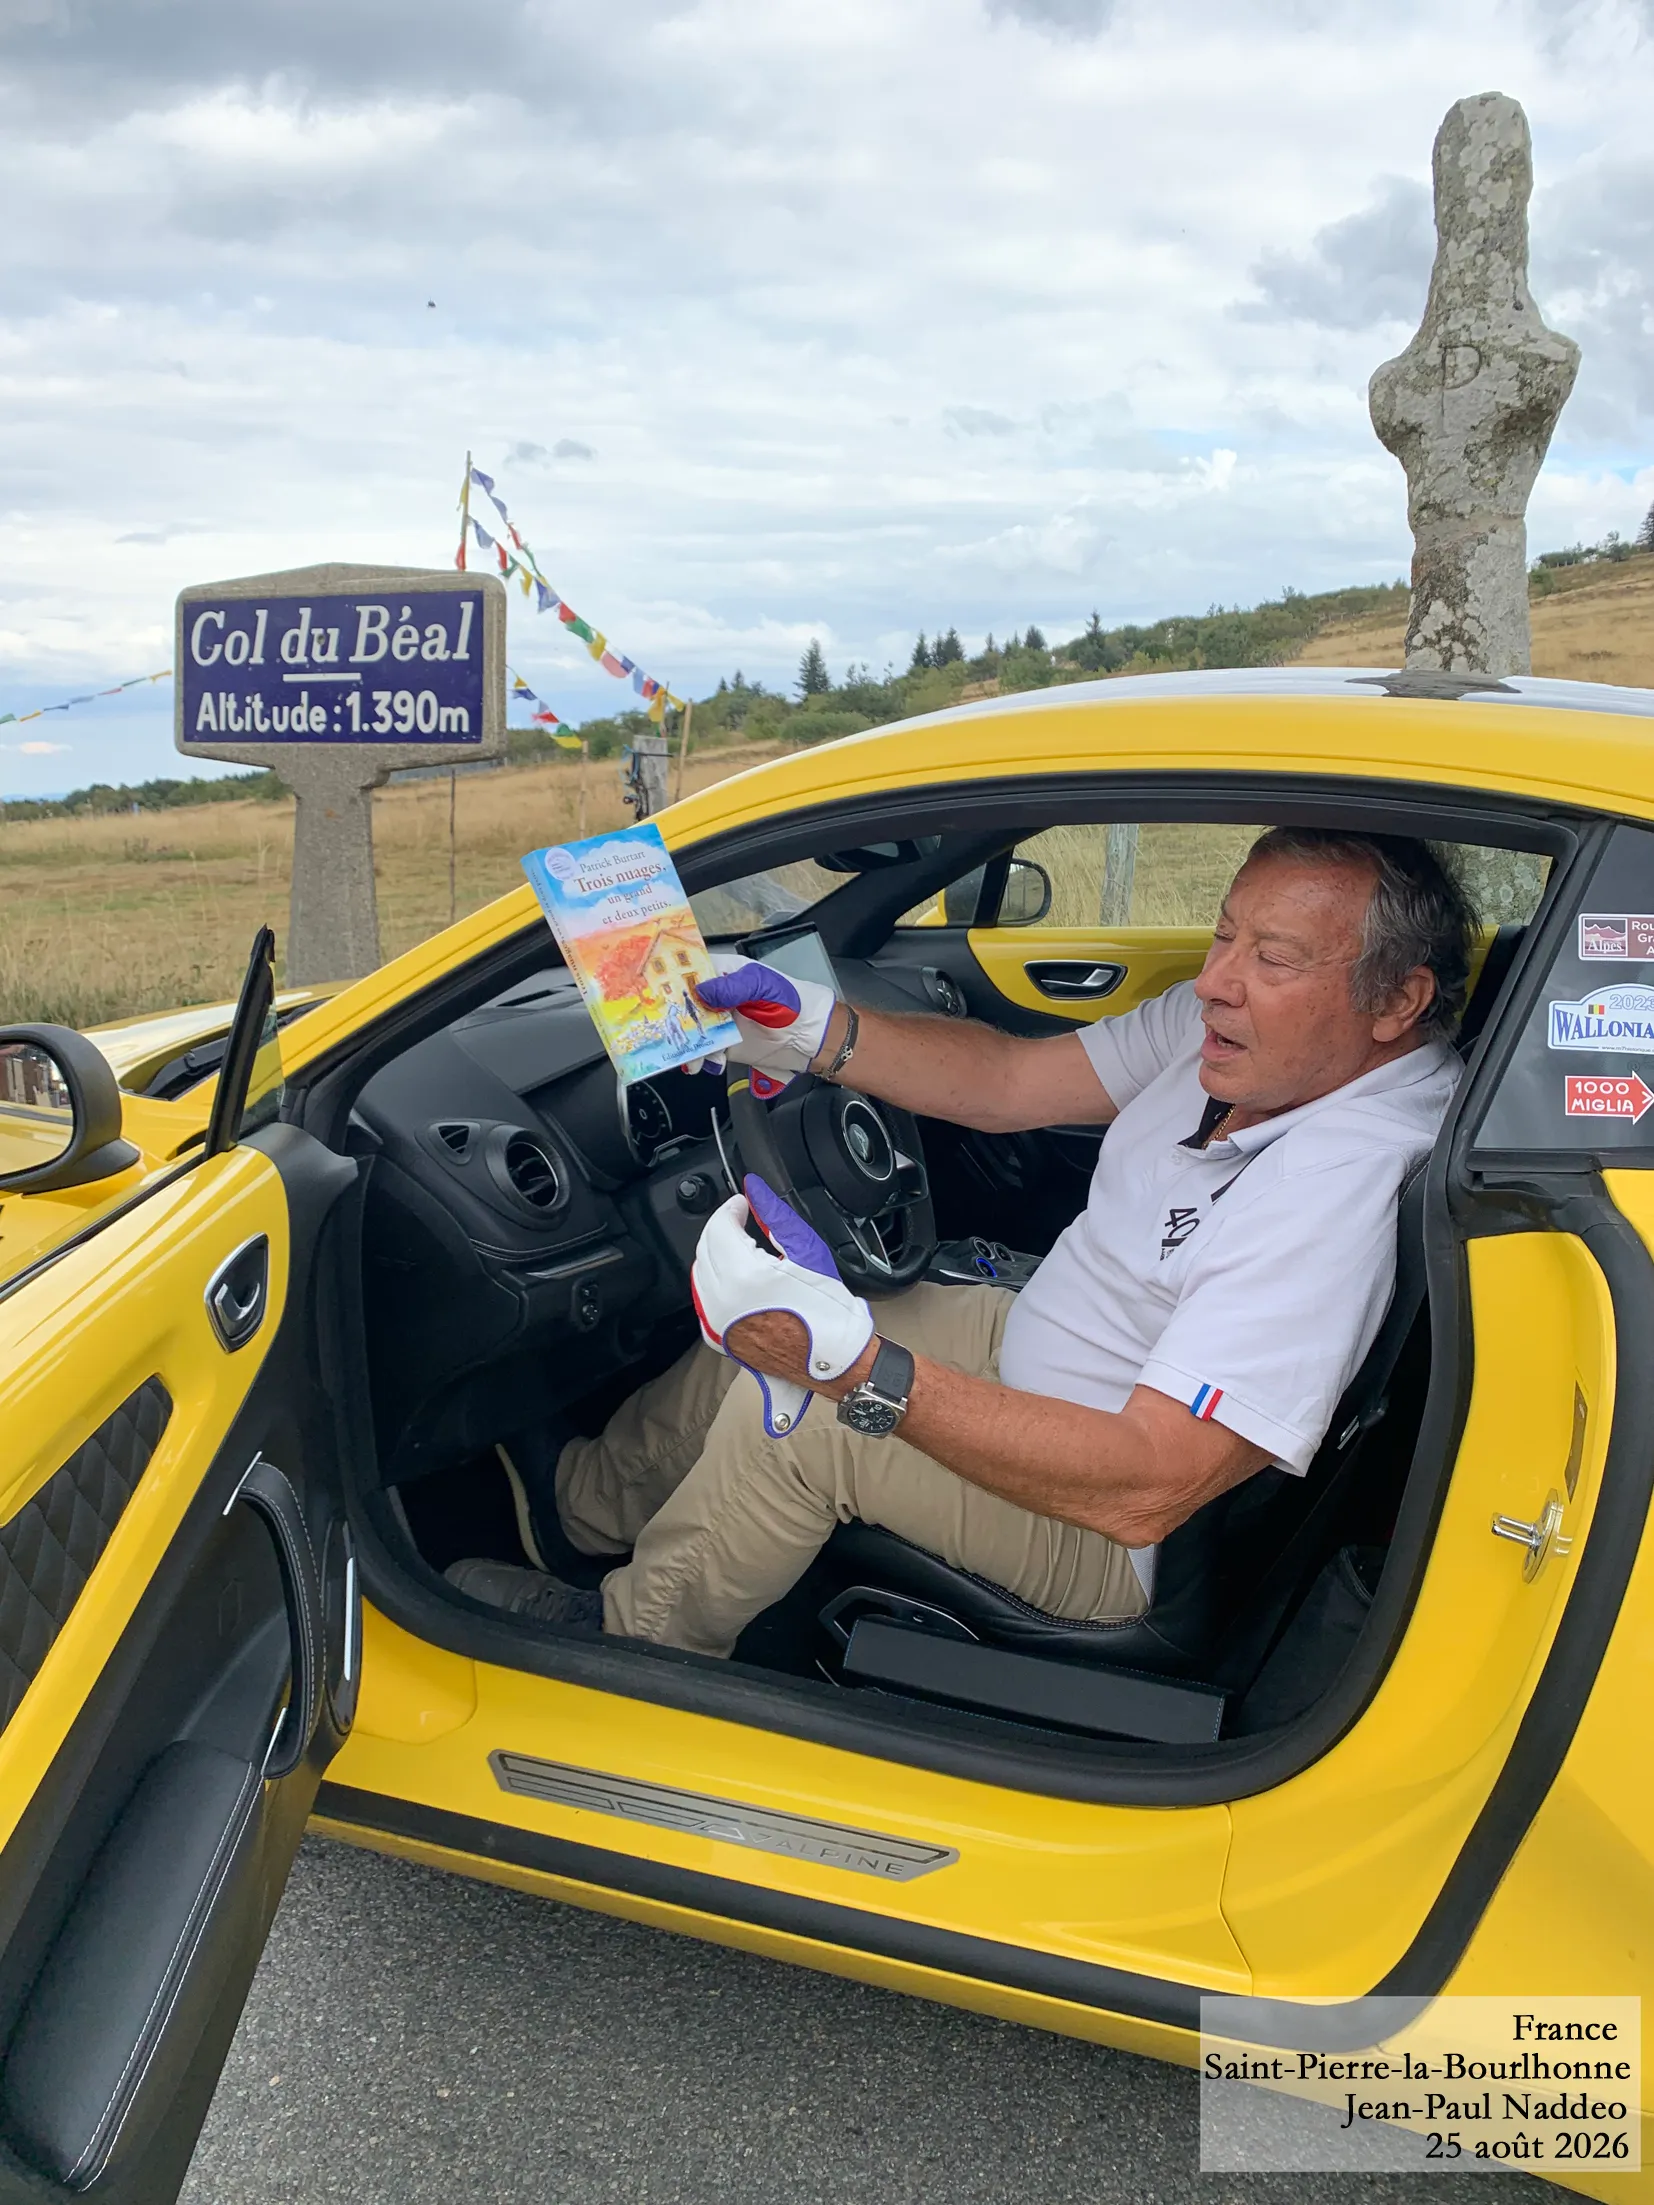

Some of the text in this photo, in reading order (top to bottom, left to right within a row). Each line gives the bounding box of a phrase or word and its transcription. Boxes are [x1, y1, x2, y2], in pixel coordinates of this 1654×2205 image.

[191, 601, 475, 666] Col du Béal
[580, 857, 612, 874] Patrick
[573, 873, 614, 893] Trois
[607, 883, 652, 905] un grand
[602, 916, 613, 925] et
[614, 909, 640, 922] deux
[1588, 938, 1625, 954] Alpes
[1637, 933, 1654, 943] Gr
[1555, 1009, 1654, 1043] WALLONIA
[1575, 1081, 1630, 1095] 1000
[1571, 1098, 1634, 1112] MIGLIA
[776, 1840, 905, 1875] ALPINE
